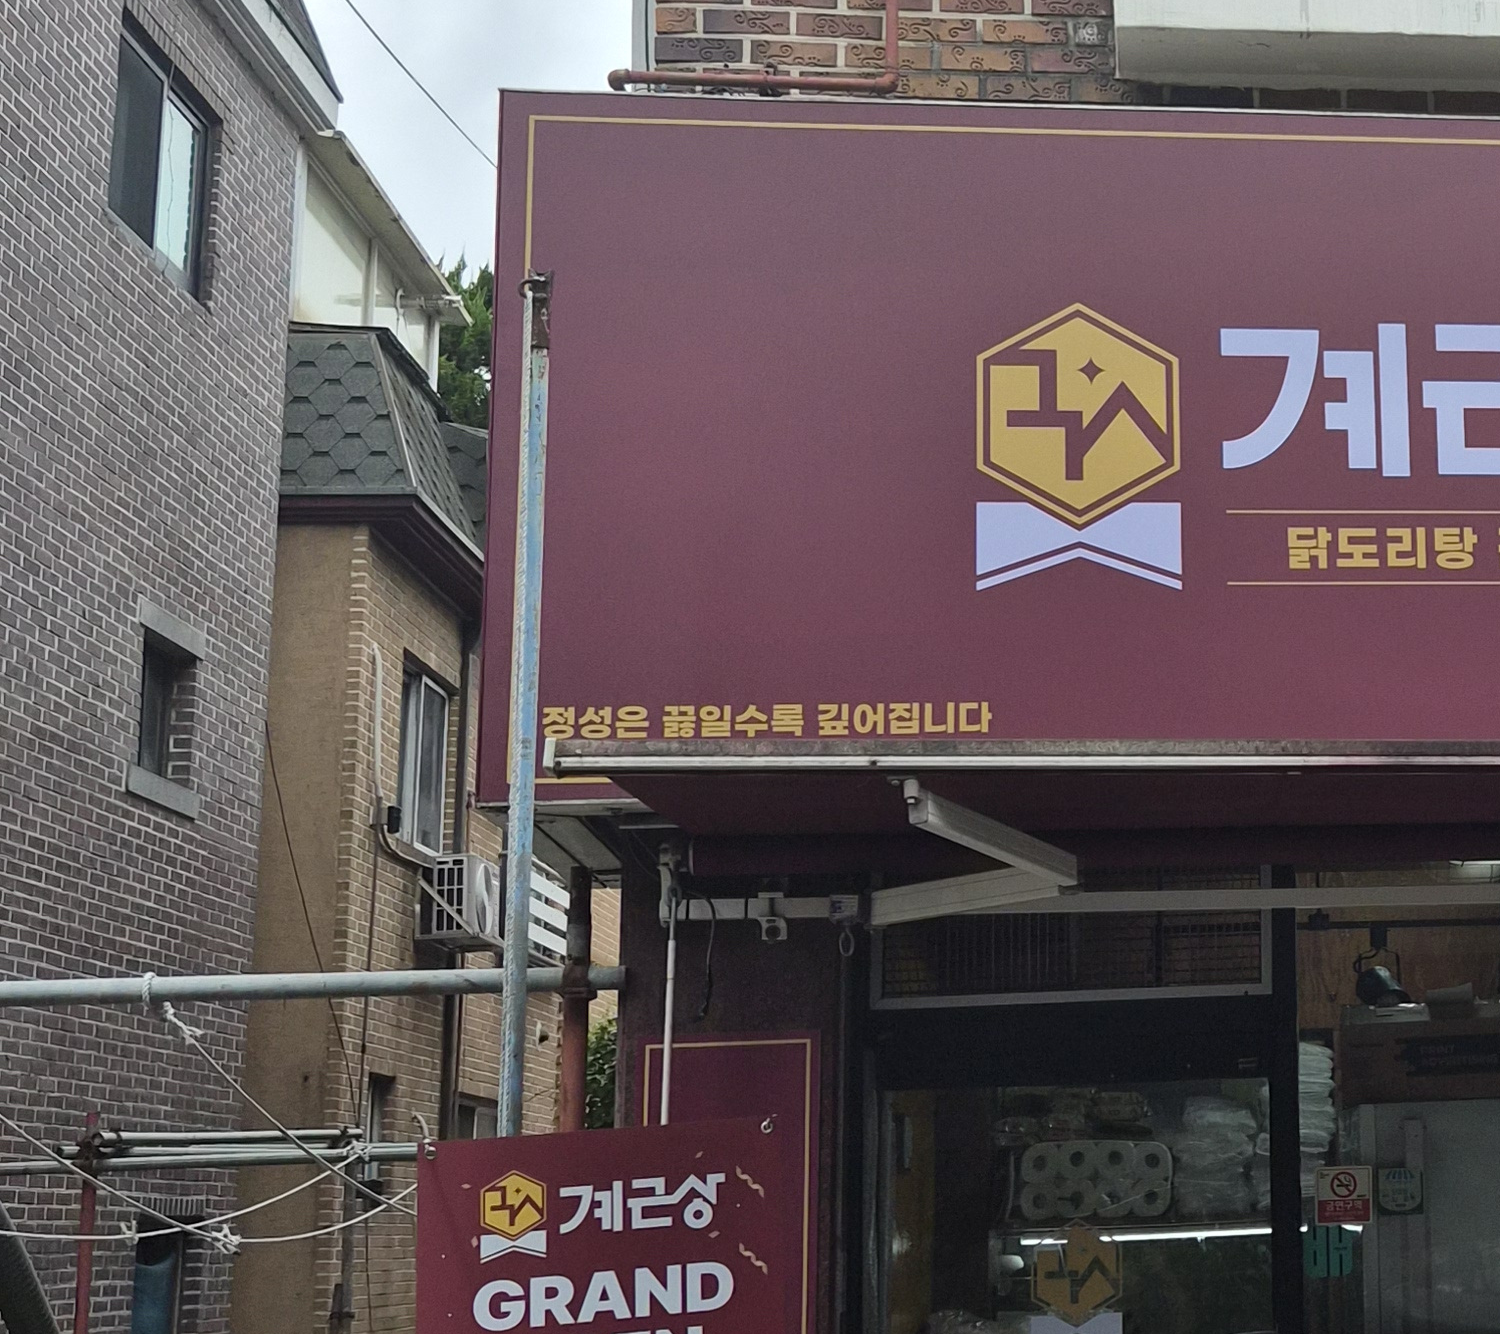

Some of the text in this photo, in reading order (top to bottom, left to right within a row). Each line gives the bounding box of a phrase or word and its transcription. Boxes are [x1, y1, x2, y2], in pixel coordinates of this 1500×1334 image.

[1286, 526, 1479, 571] 닭도리탕
[542, 701, 993, 740] 정성은 끓일수록 깊어집니다
[559, 1173, 726, 1234] 계근상
[472, 1261, 735, 1333] GRAND
